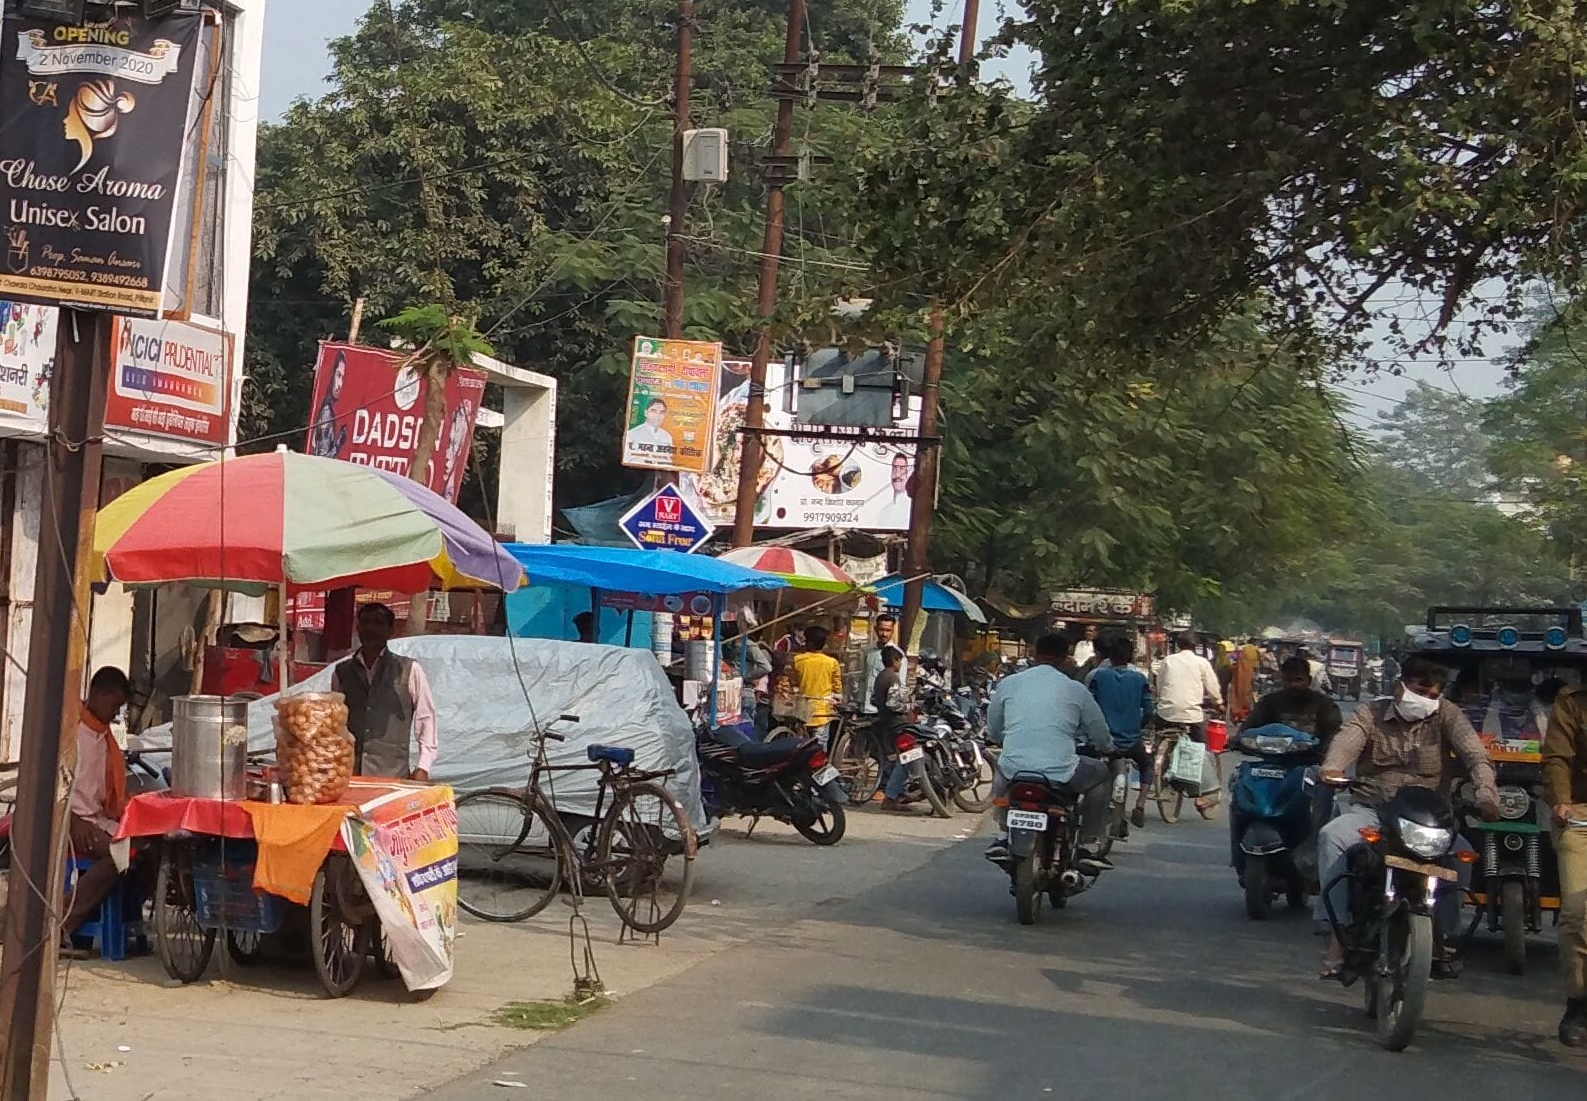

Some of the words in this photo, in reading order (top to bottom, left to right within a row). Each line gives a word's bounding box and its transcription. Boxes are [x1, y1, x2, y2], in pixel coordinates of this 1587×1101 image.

[53, 26, 131, 45] OPENING
[39, 54, 48, 66] 2
[52, 51, 118, 66] November
[120, 56, 154, 75] 2020
[0, 158, 73, 194] Chose
[77, 166, 166, 201] Aroma
[10, 199, 80, 232] Unisex
[84, 205, 146, 235] Salon
[130, 333, 163, 362] ICICI
[164, 340, 214, 377] PRUDENTIAL
[662, 499, 677, 513] V
[803, 512, 859, 523] 9917909324
